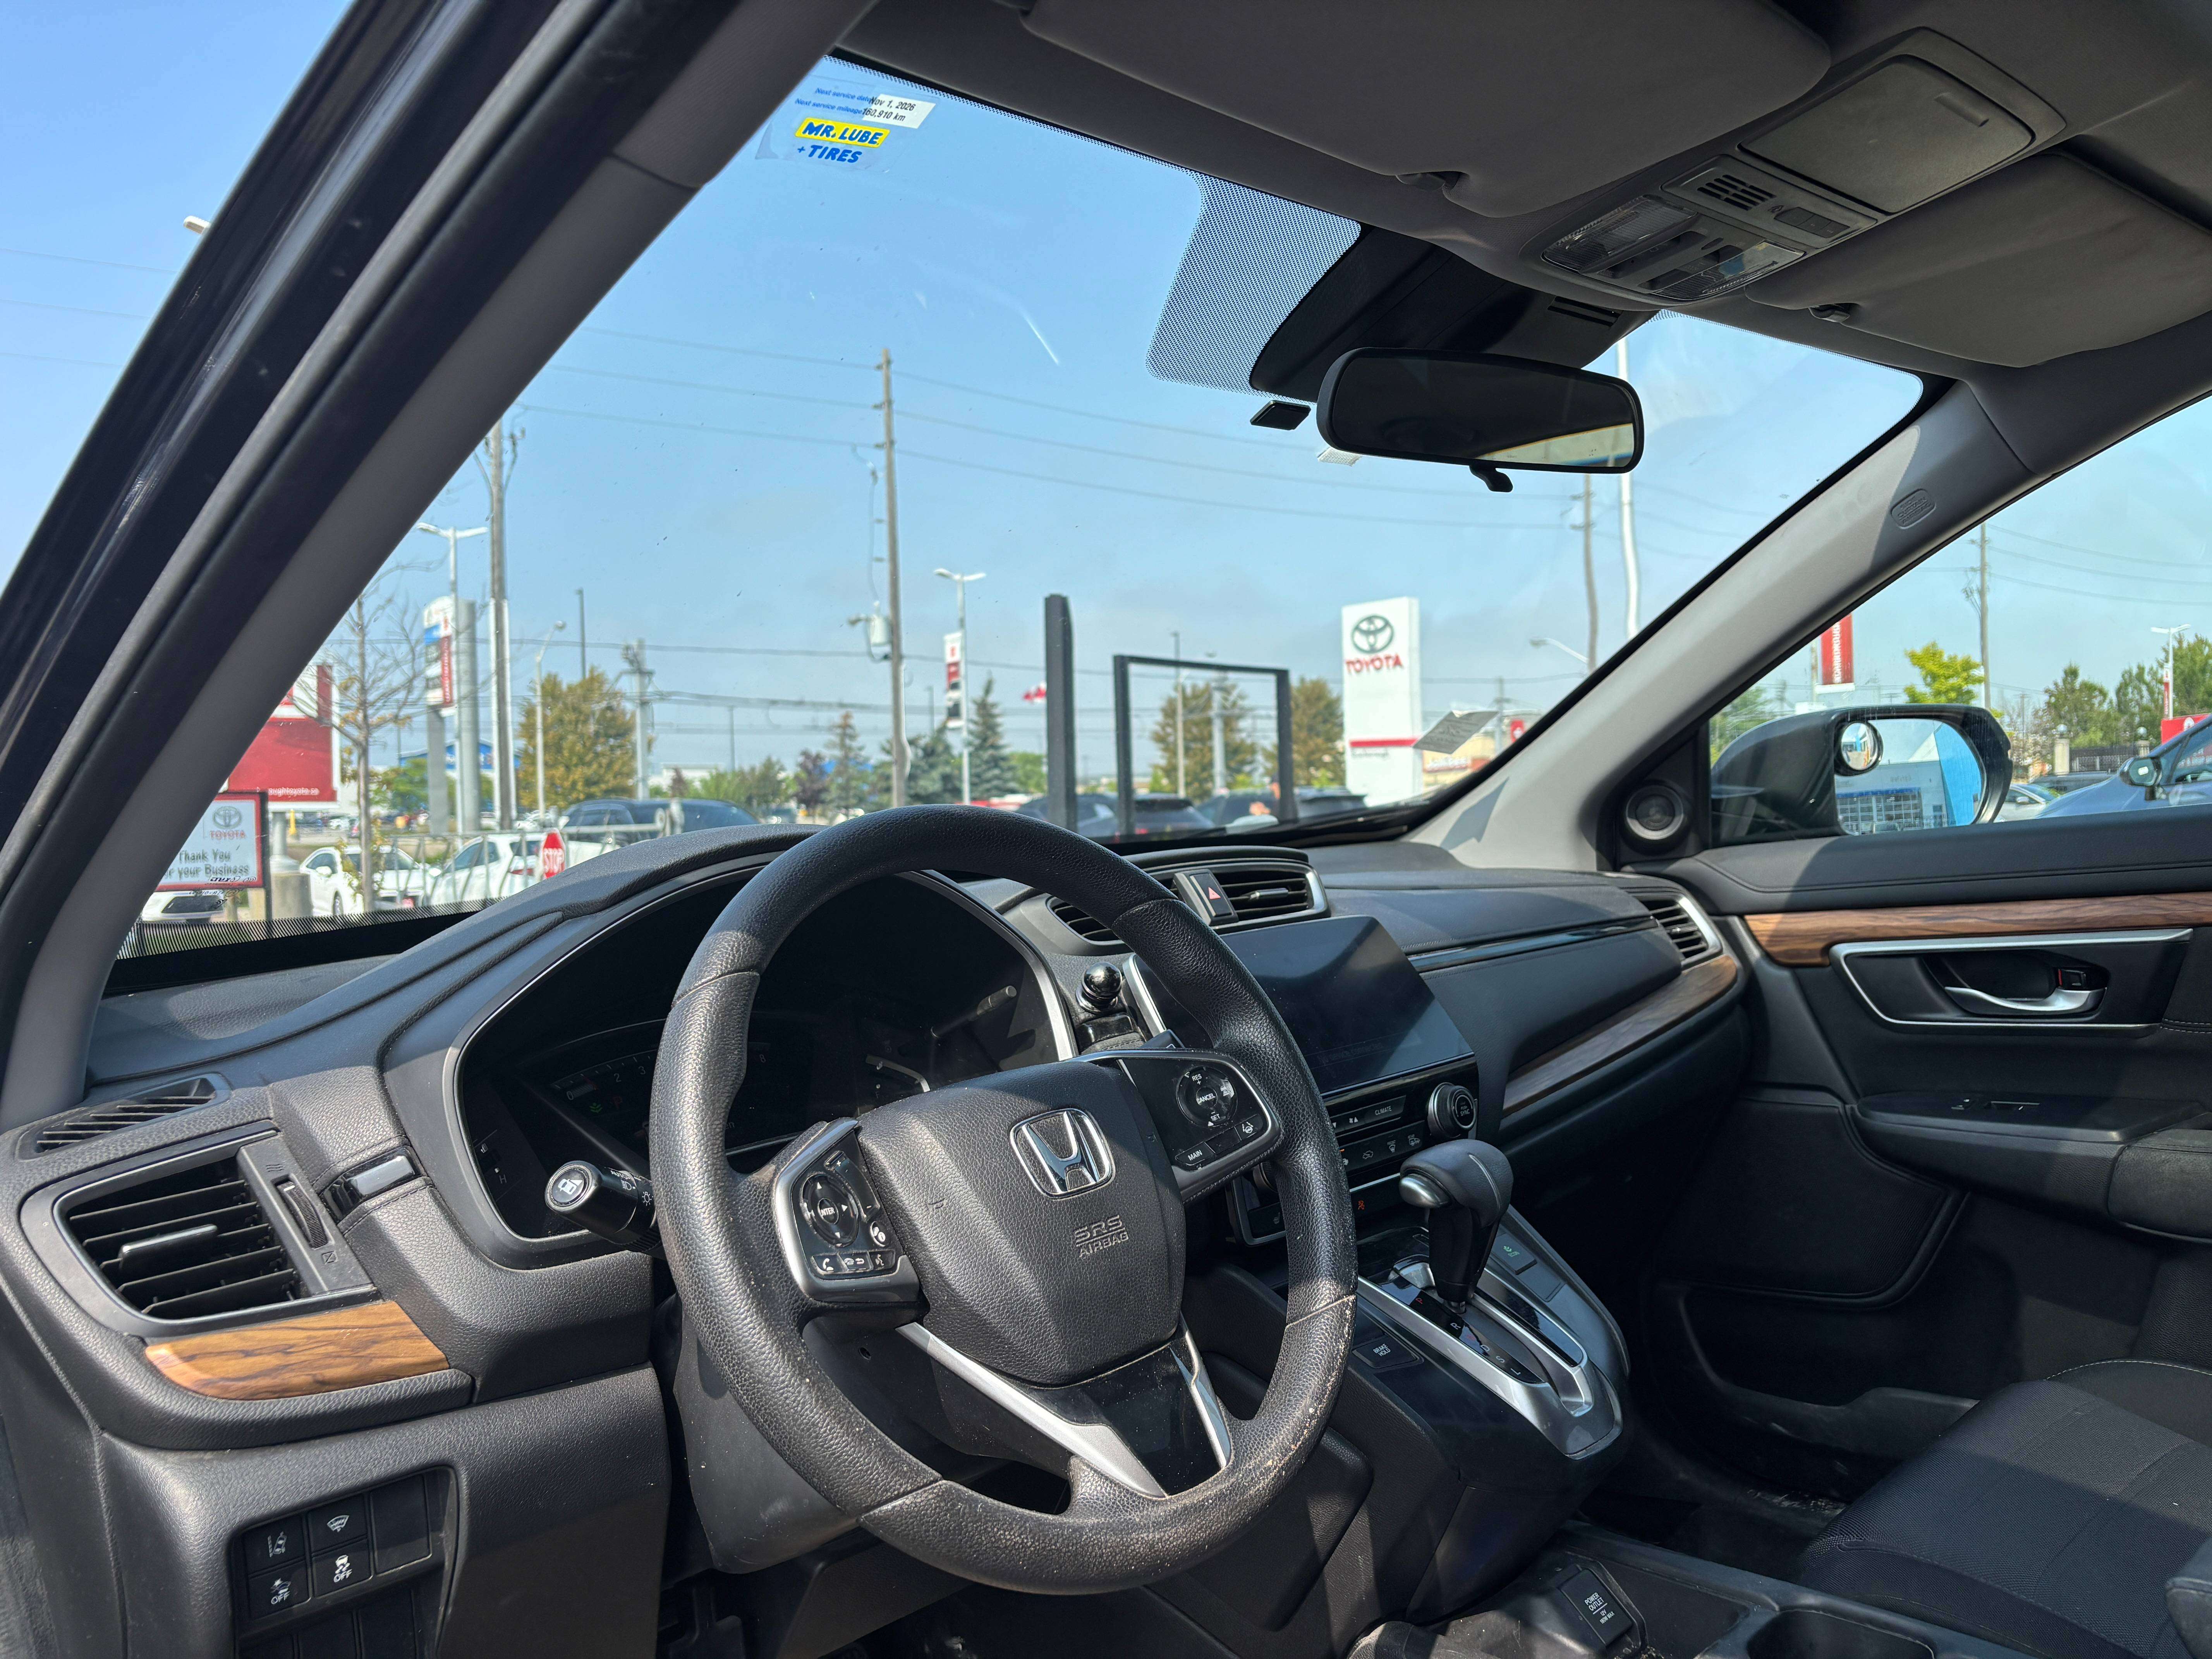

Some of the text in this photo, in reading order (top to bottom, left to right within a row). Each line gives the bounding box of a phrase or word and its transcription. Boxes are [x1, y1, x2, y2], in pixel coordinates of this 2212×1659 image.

[832, 91, 855, 100] service
[869, 96, 916, 111] Nov 1, 2026
[893, 113, 906, 121] km
[802, 122, 883, 144] MR. LUBE
[808, 145, 862, 163] TIRES
[1346, 653, 1403, 673] TOYOTA
[210, 830, 246, 840] TOYOTA
[212, 849, 231, 863] You
[543, 848, 564, 873] STOP
[178, 866, 202, 881] your
[204, 864, 250, 878] Business
[613, 1073, 622, 1083] 2
[1375, 1106, 1392, 1115] CLIMATE
[1188, 1149, 1202, 1161] MAIN
[821, 1207, 835, 1216] NTER
[1074, 1214, 1122, 1243] SRS
[1079, 1231, 1129, 1258] AIRBAG
[1373, 1344, 1389, 1355] BRAKE
[1378, 1348, 1391, 1357] HOLD
[333, 1568, 352, 1583] OFF
[271, 1590, 290, 1605] OFF
[1584, 1592, 1600, 1606] POWER
[1589, 1597, 1604, 1611] OUTLET
[1606, 1611, 1615, 1619] MAX
